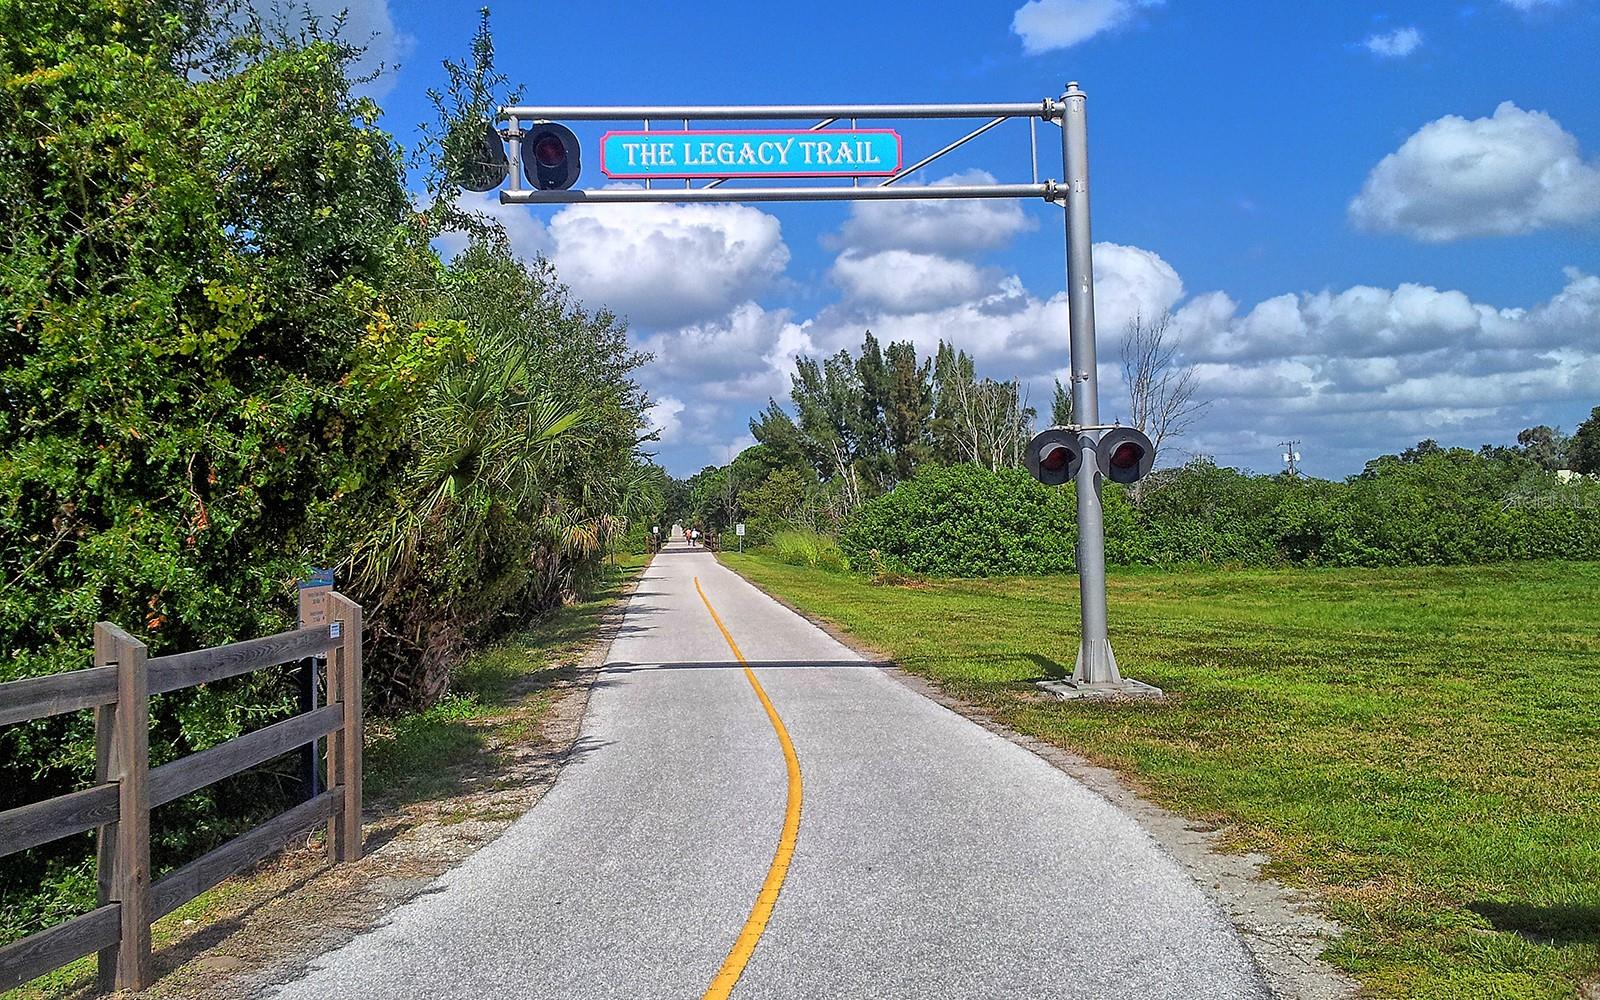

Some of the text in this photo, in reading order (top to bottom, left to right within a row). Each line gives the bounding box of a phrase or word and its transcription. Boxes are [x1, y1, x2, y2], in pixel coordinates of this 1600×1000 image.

[622, 136, 881, 166] THE LEGACY TRAIL
